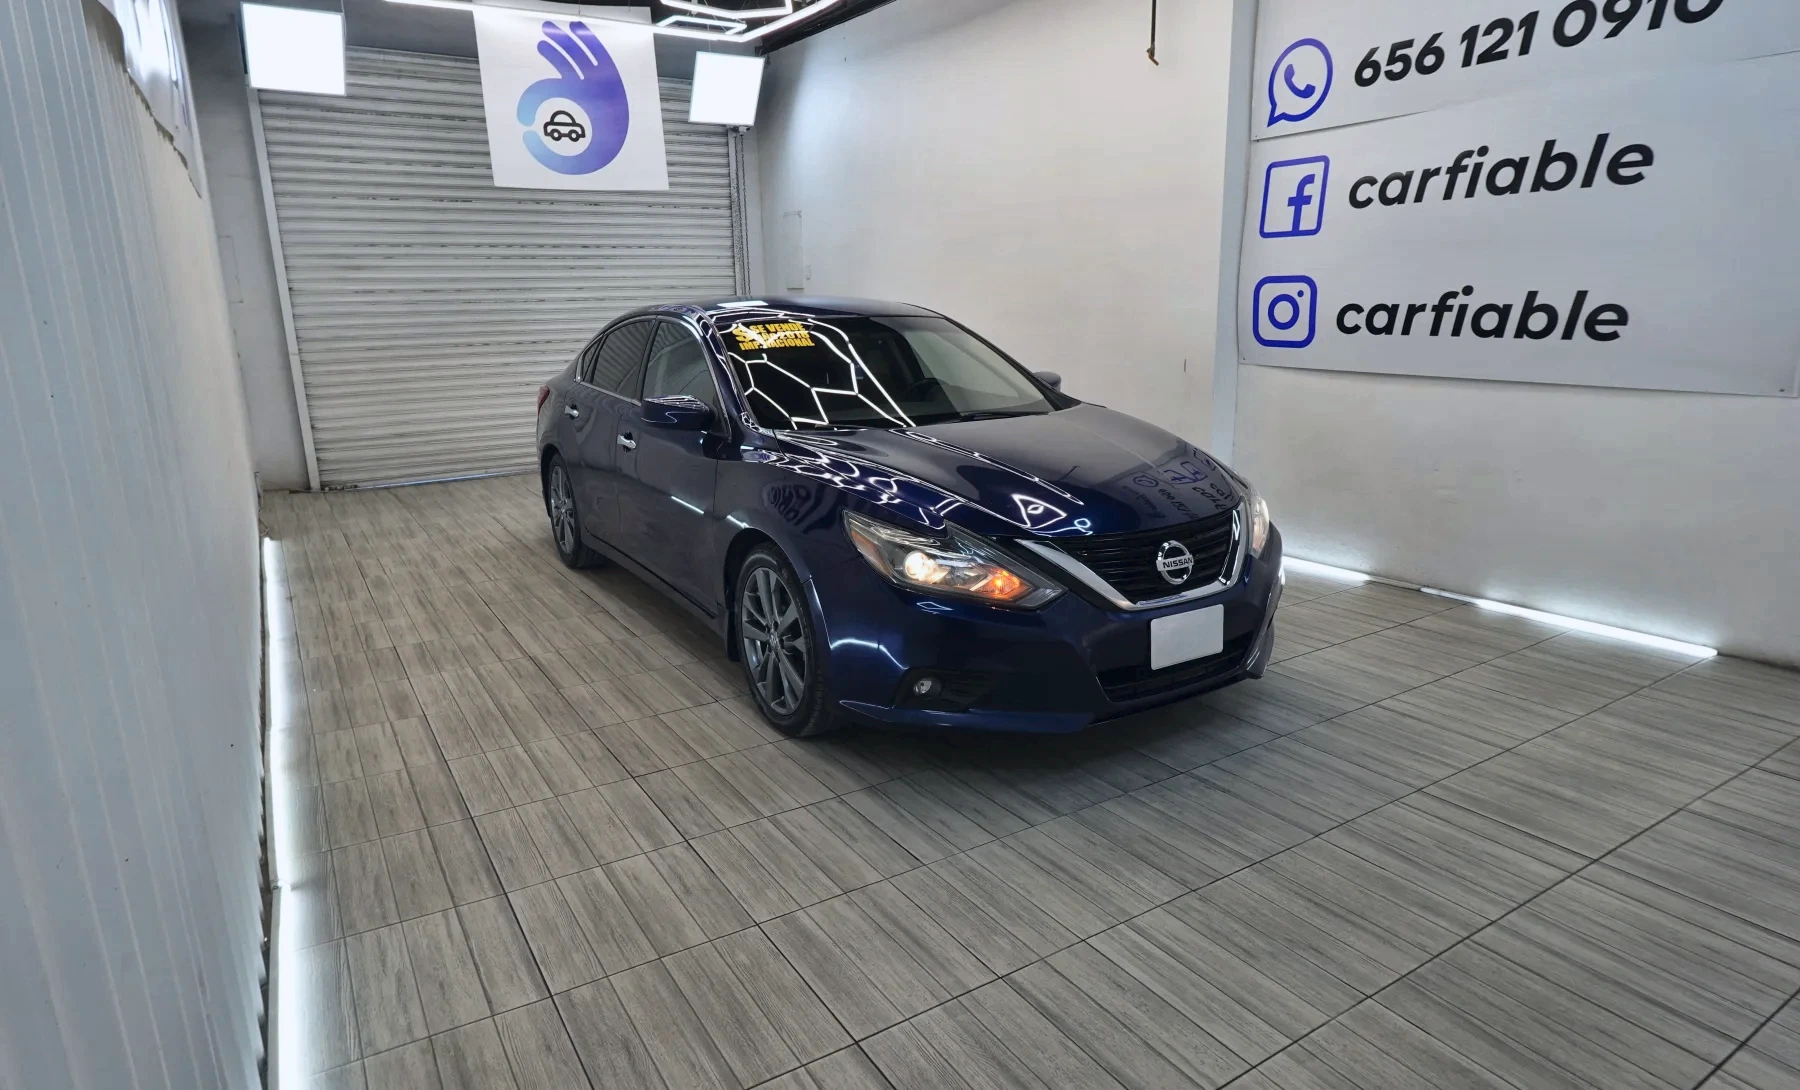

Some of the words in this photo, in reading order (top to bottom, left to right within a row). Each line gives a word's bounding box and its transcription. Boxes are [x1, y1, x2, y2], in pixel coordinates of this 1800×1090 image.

[1354, 31, 1445, 88] 656
[1460, 10, 1540, 69] 121
[1348, 132, 1654, 209] carfiable
[749, 325, 767, 333] SE
[765, 322, 806, 332] VENDE
[1336, 284, 1629, 342] carfiable
[764, 338, 815, 348] NACIONAL
[1162, 556, 1193, 568] NISSAN
